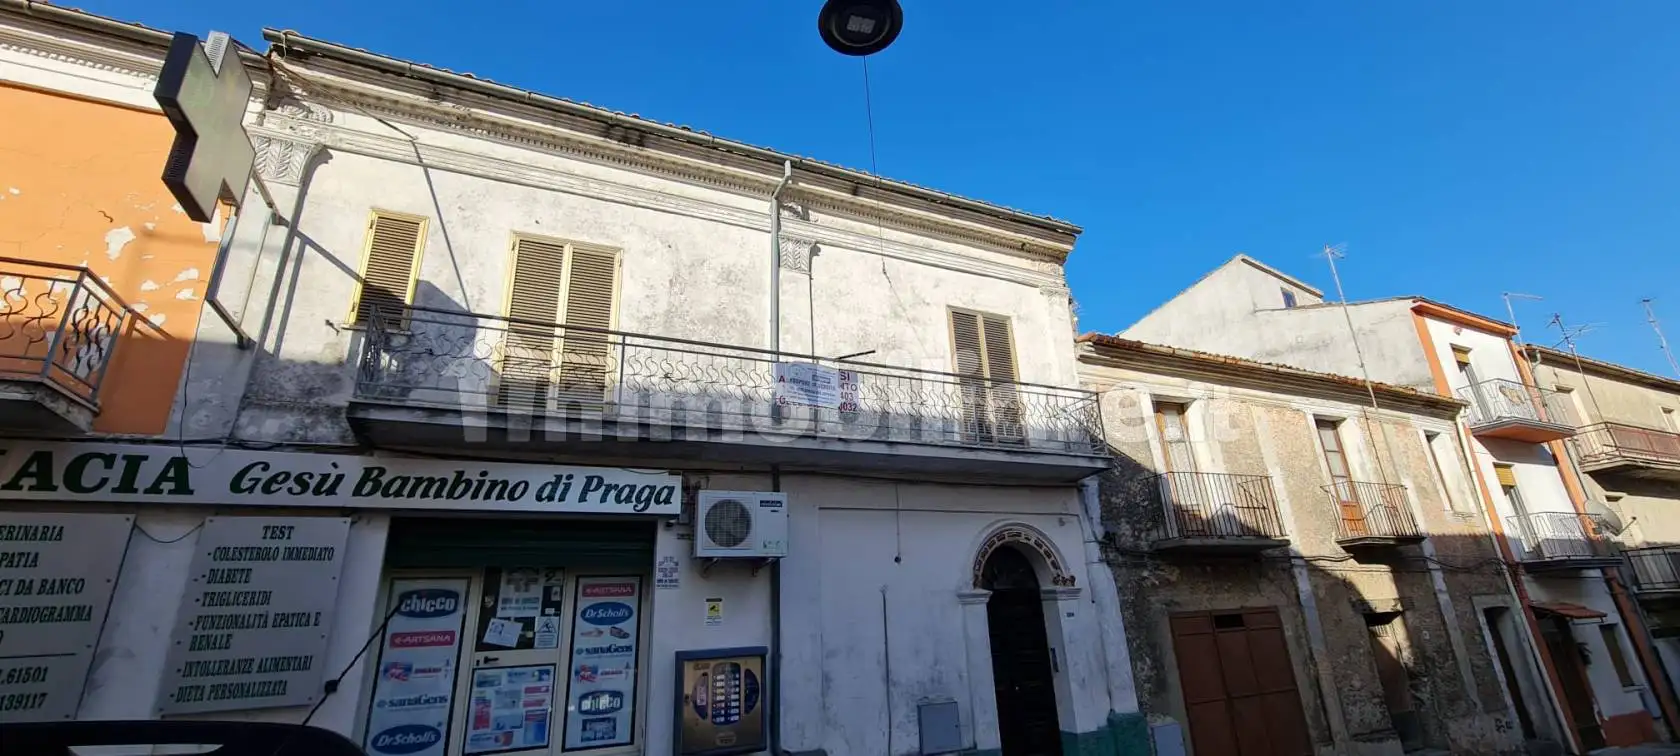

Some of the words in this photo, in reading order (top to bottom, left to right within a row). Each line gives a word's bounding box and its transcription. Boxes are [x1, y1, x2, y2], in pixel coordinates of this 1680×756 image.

[0, 450, 195, 496] ACIA
[229, 461, 344, 498] Gesù
[352, 466, 530, 502] Bambino
[535, 473, 574, 503] di
[578, 475, 676, 512] Praga
[262, 526, 295, 540] TEST
[282, 547, 335, 562] IMMEDIATO
[14, 579, 34, 596] DA
[37, 578, 85, 596] BANCO
[401, 593, 456, 613] chicco
[271, 612, 311, 629] EPATICA
[314, 612, 322, 627] E
[189, 634, 233, 652] RENALE
[255, 655, 313, 674] ALIMENTARI
[207, 680, 288, 701] PERSONALIZZATA
